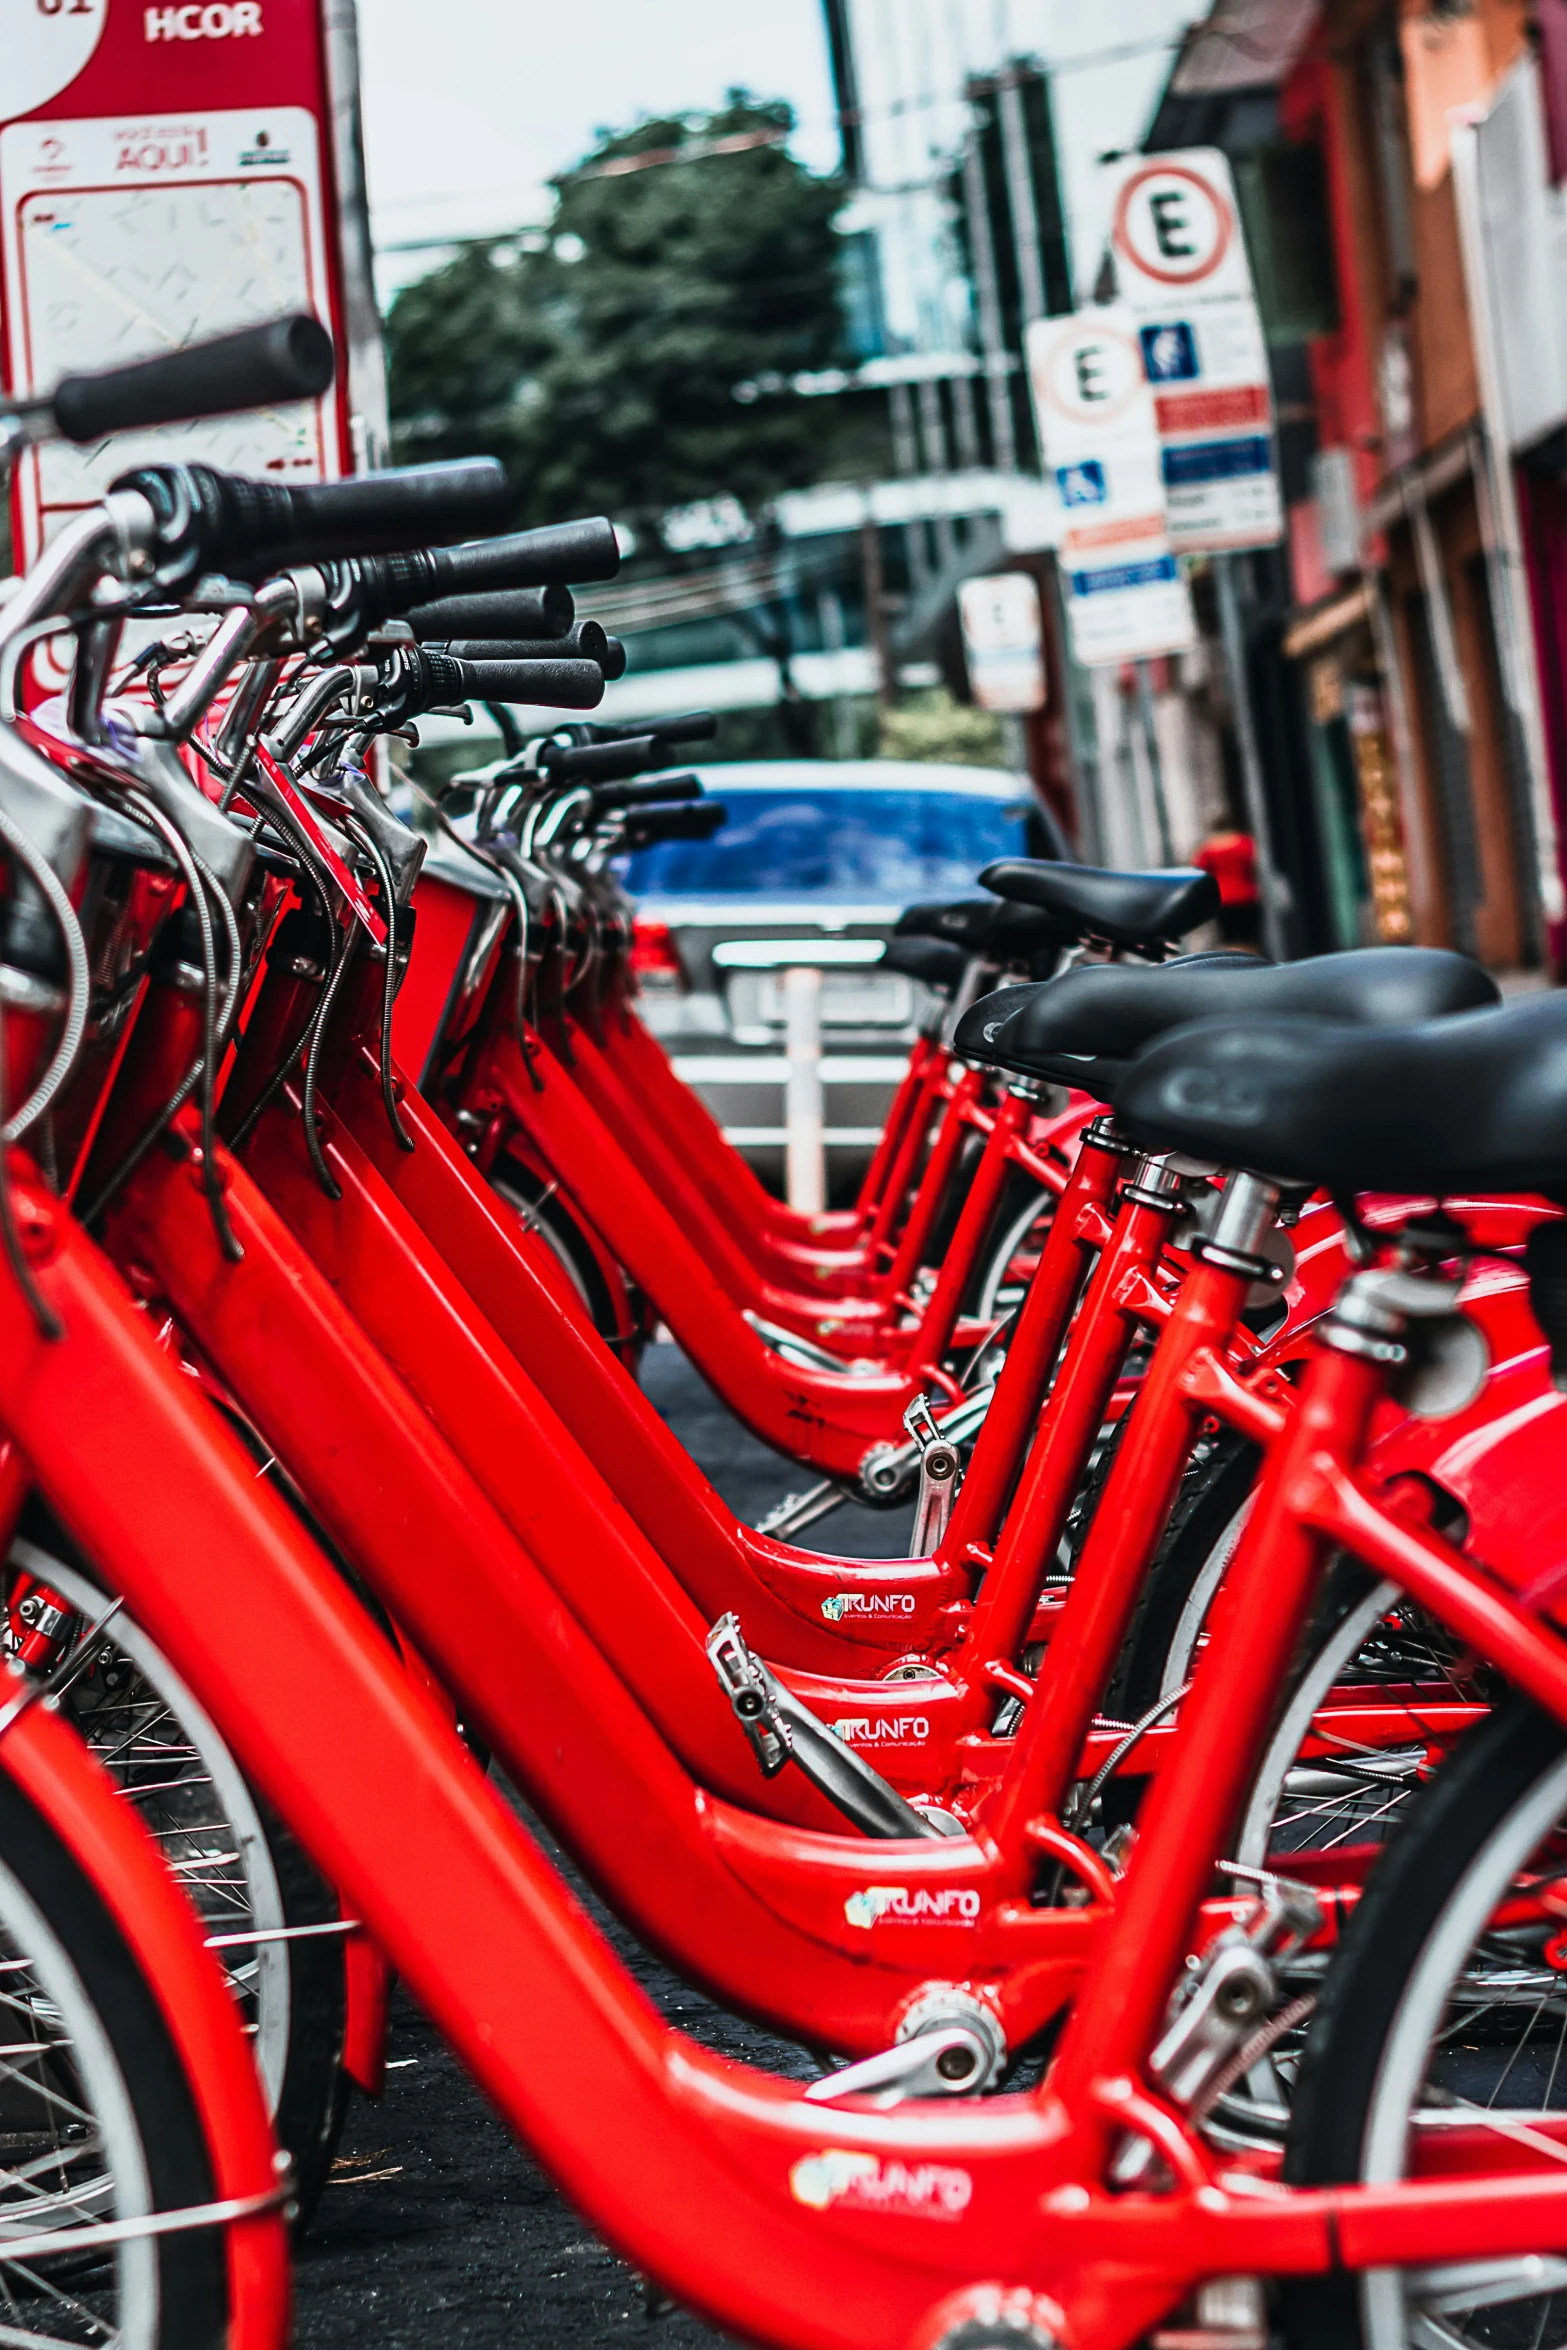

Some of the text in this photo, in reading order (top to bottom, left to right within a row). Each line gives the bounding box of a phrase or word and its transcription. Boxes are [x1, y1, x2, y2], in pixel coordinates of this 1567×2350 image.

[145, 2, 263, 42] HCOR
[1148, 190, 1196, 258] E
[1074, 345, 1110, 402] E
[836, 1593, 915, 1613] TRUNFO
[836, 1717, 929, 1741] TRUNFO
[865, 1885, 980, 1918] TRUNFO
